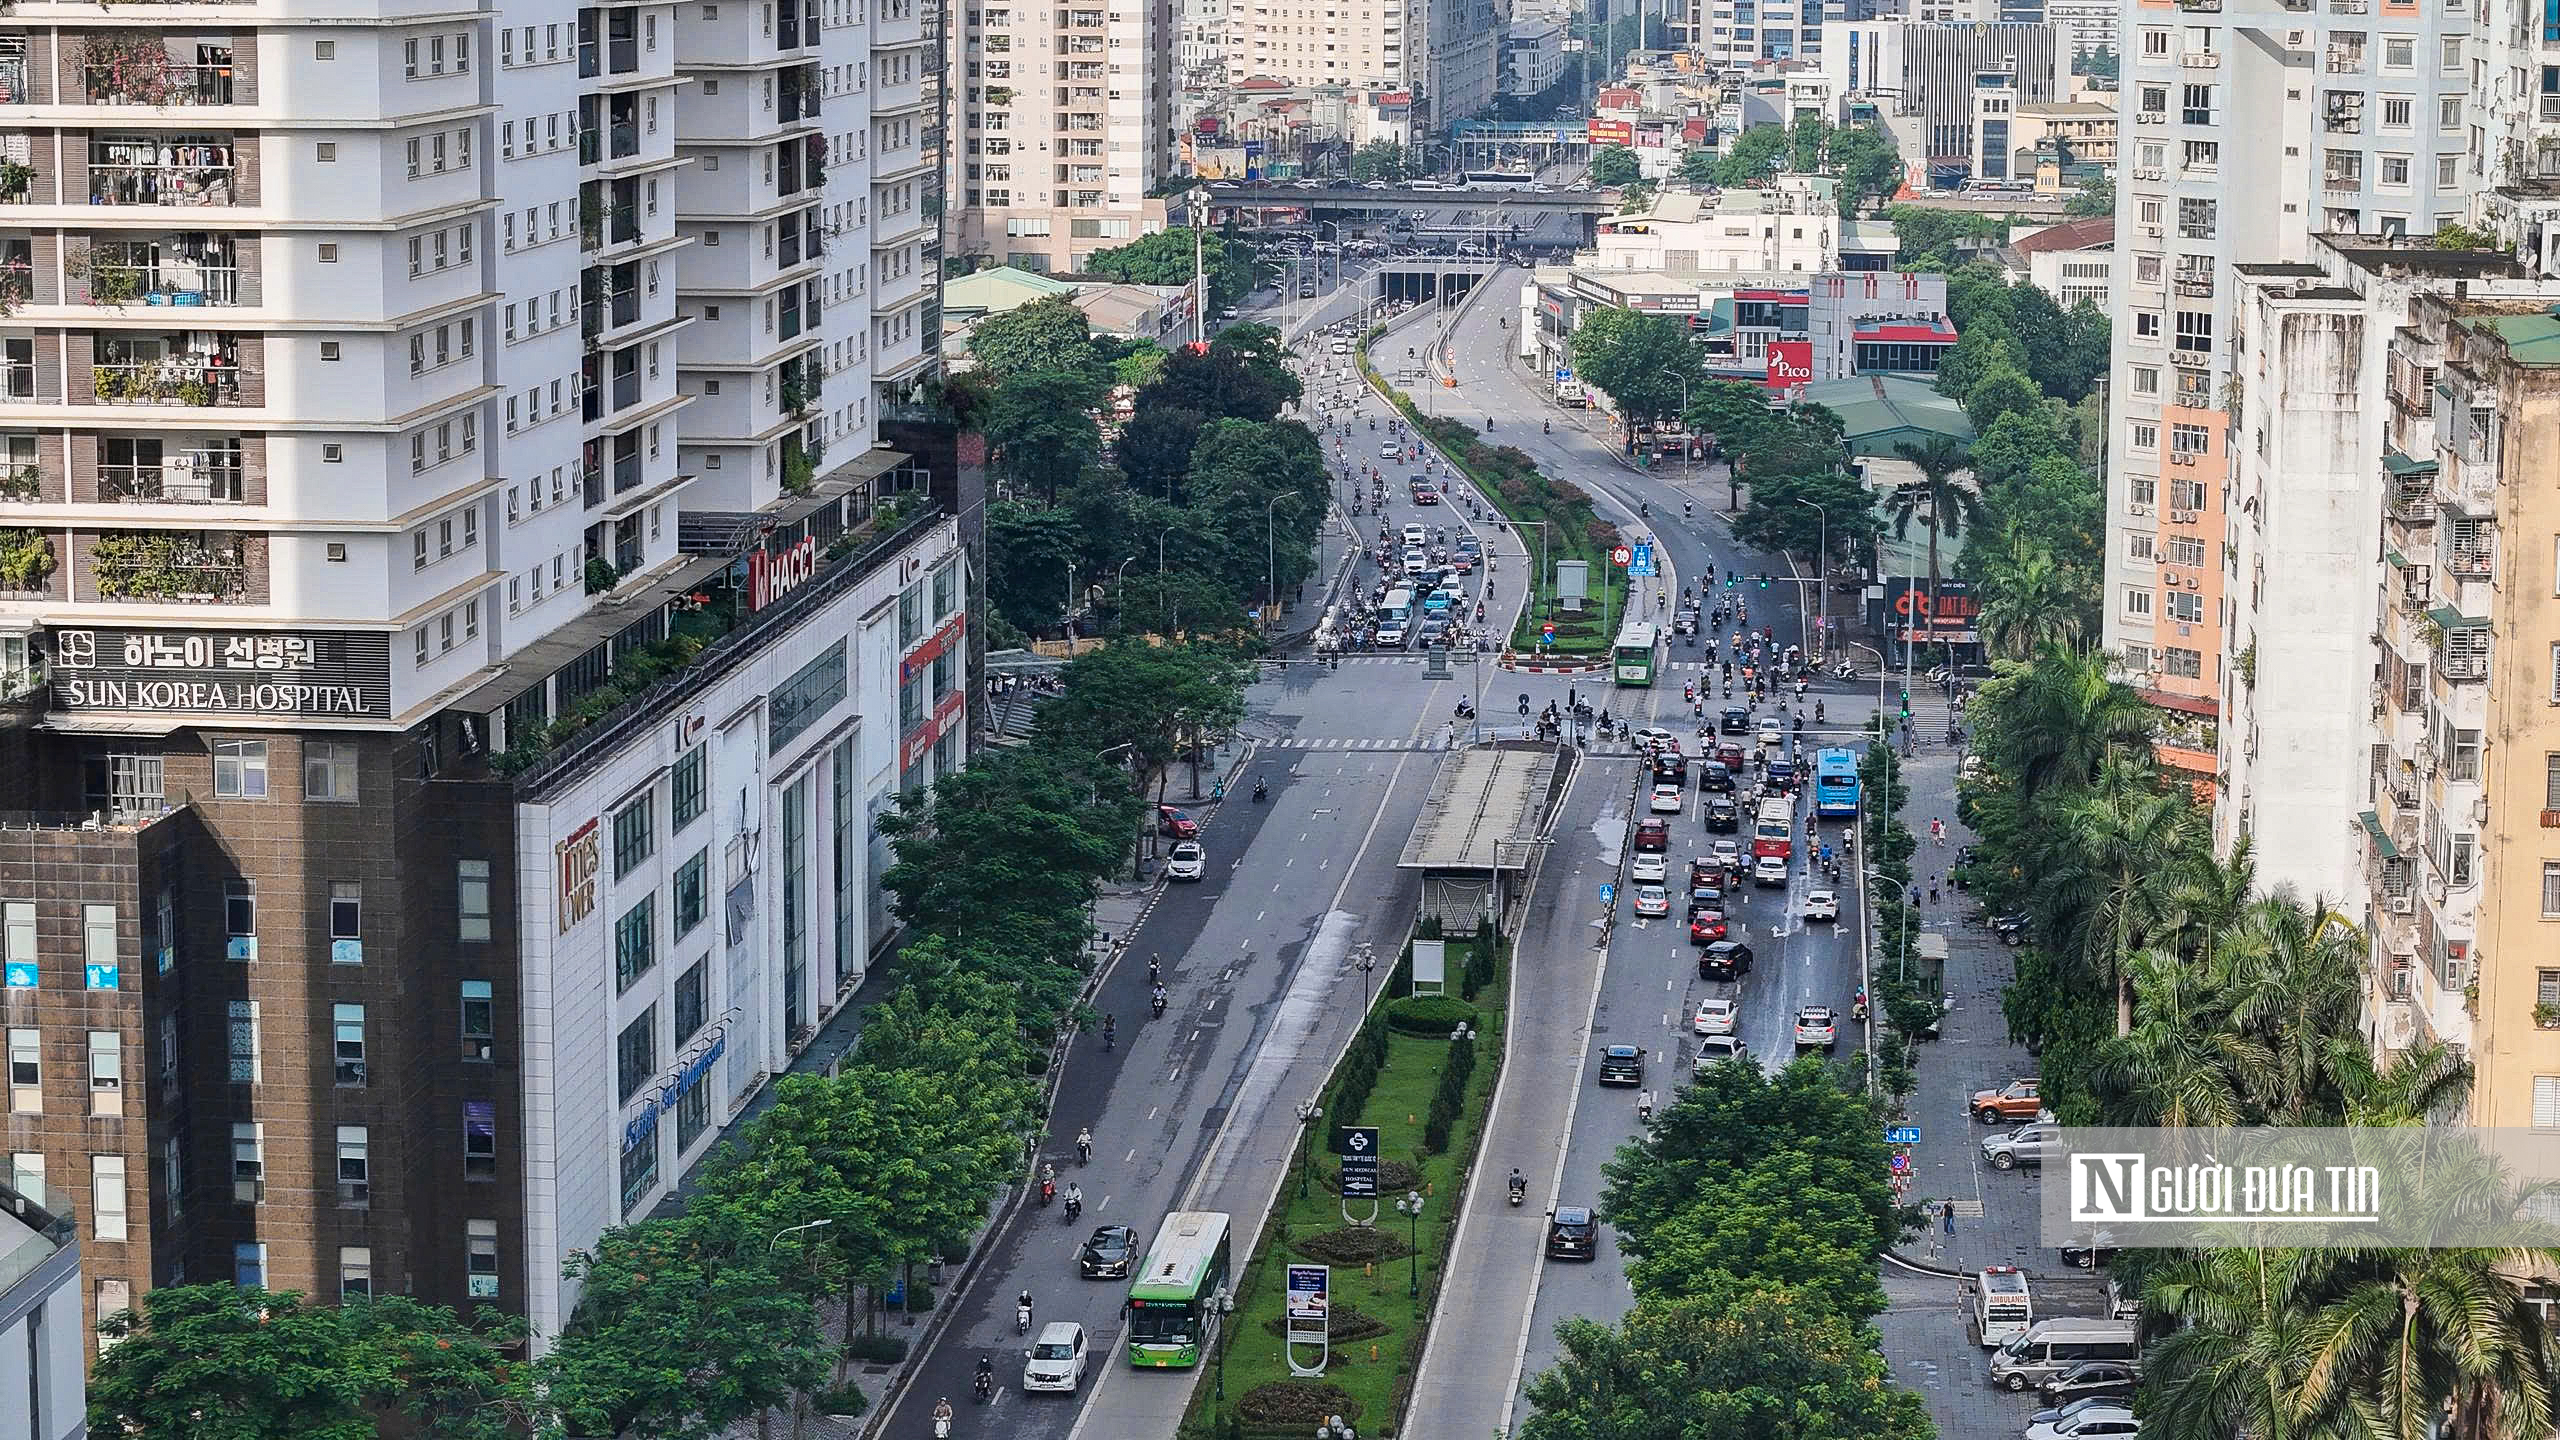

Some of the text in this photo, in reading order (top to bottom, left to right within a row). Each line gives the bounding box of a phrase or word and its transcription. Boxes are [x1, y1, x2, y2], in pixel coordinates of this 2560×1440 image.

[123, 634, 316, 671] 하노이 선병원
[69, 680, 371, 713] SUN KOREA HOSPITAL
[1989, 1295, 2029, 1304] AMBULANCE
